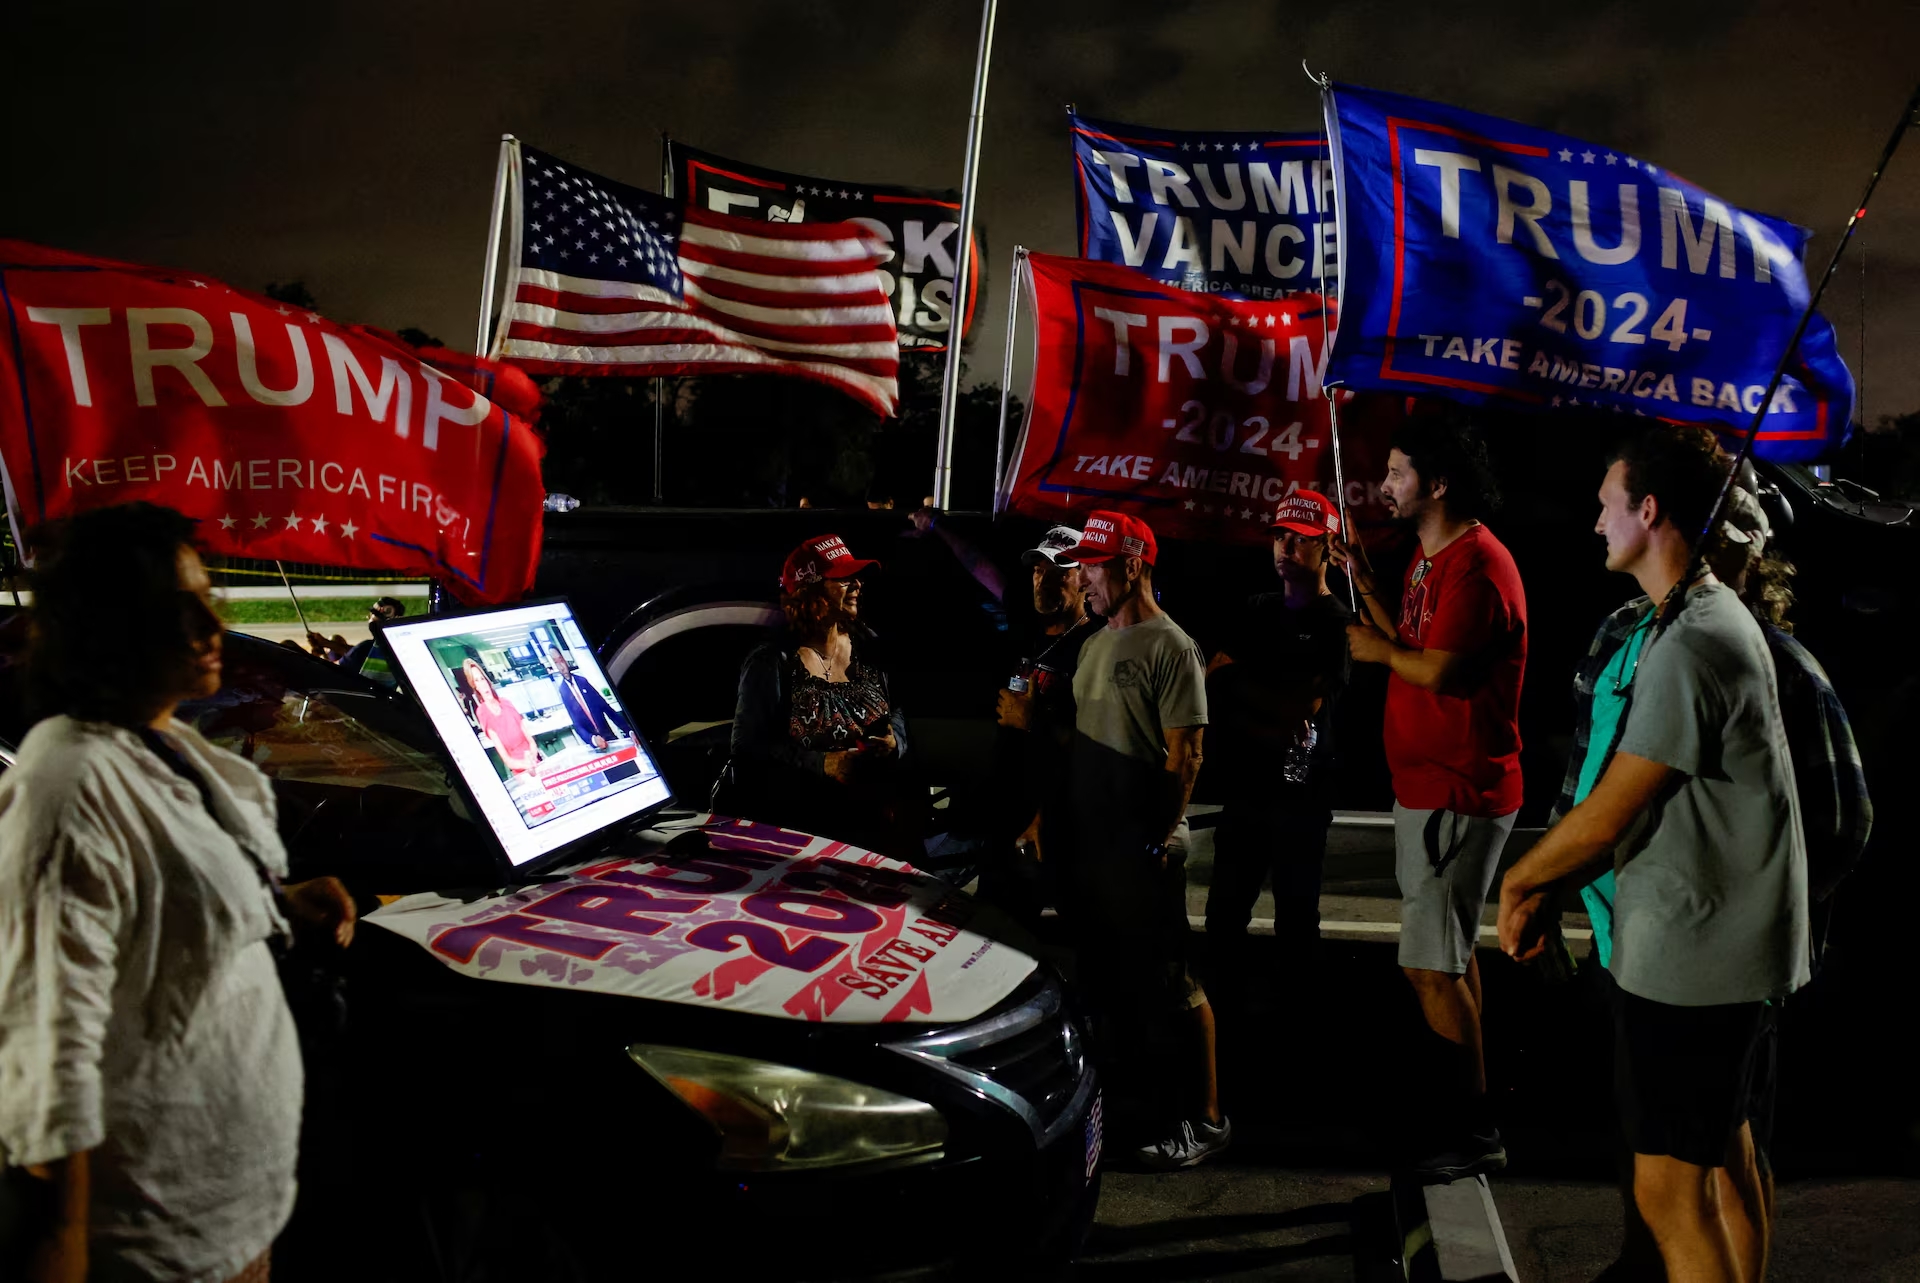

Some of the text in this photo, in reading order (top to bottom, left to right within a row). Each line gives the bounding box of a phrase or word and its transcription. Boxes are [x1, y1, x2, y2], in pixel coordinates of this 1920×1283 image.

[1110, 210, 1338, 280] VANCE
[1415, 147, 1794, 284] TRUMP
[1524, 280, 1712, 352] -2024-
[27, 305, 491, 452] TRUMP
[1094, 306, 1336, 402] TRUM
[1418, 333, 1799, 415] TAKE AMERICA BACK
[1162, 400, 1320, 461] -2024-
[65, 454, 177, 488] KEEP
[186, 456, 371, 501] AMERICA
[1073, 455, 1384, 507] TAKE AMERICA ACK
[838, 937, 937, 1000] SAVE
